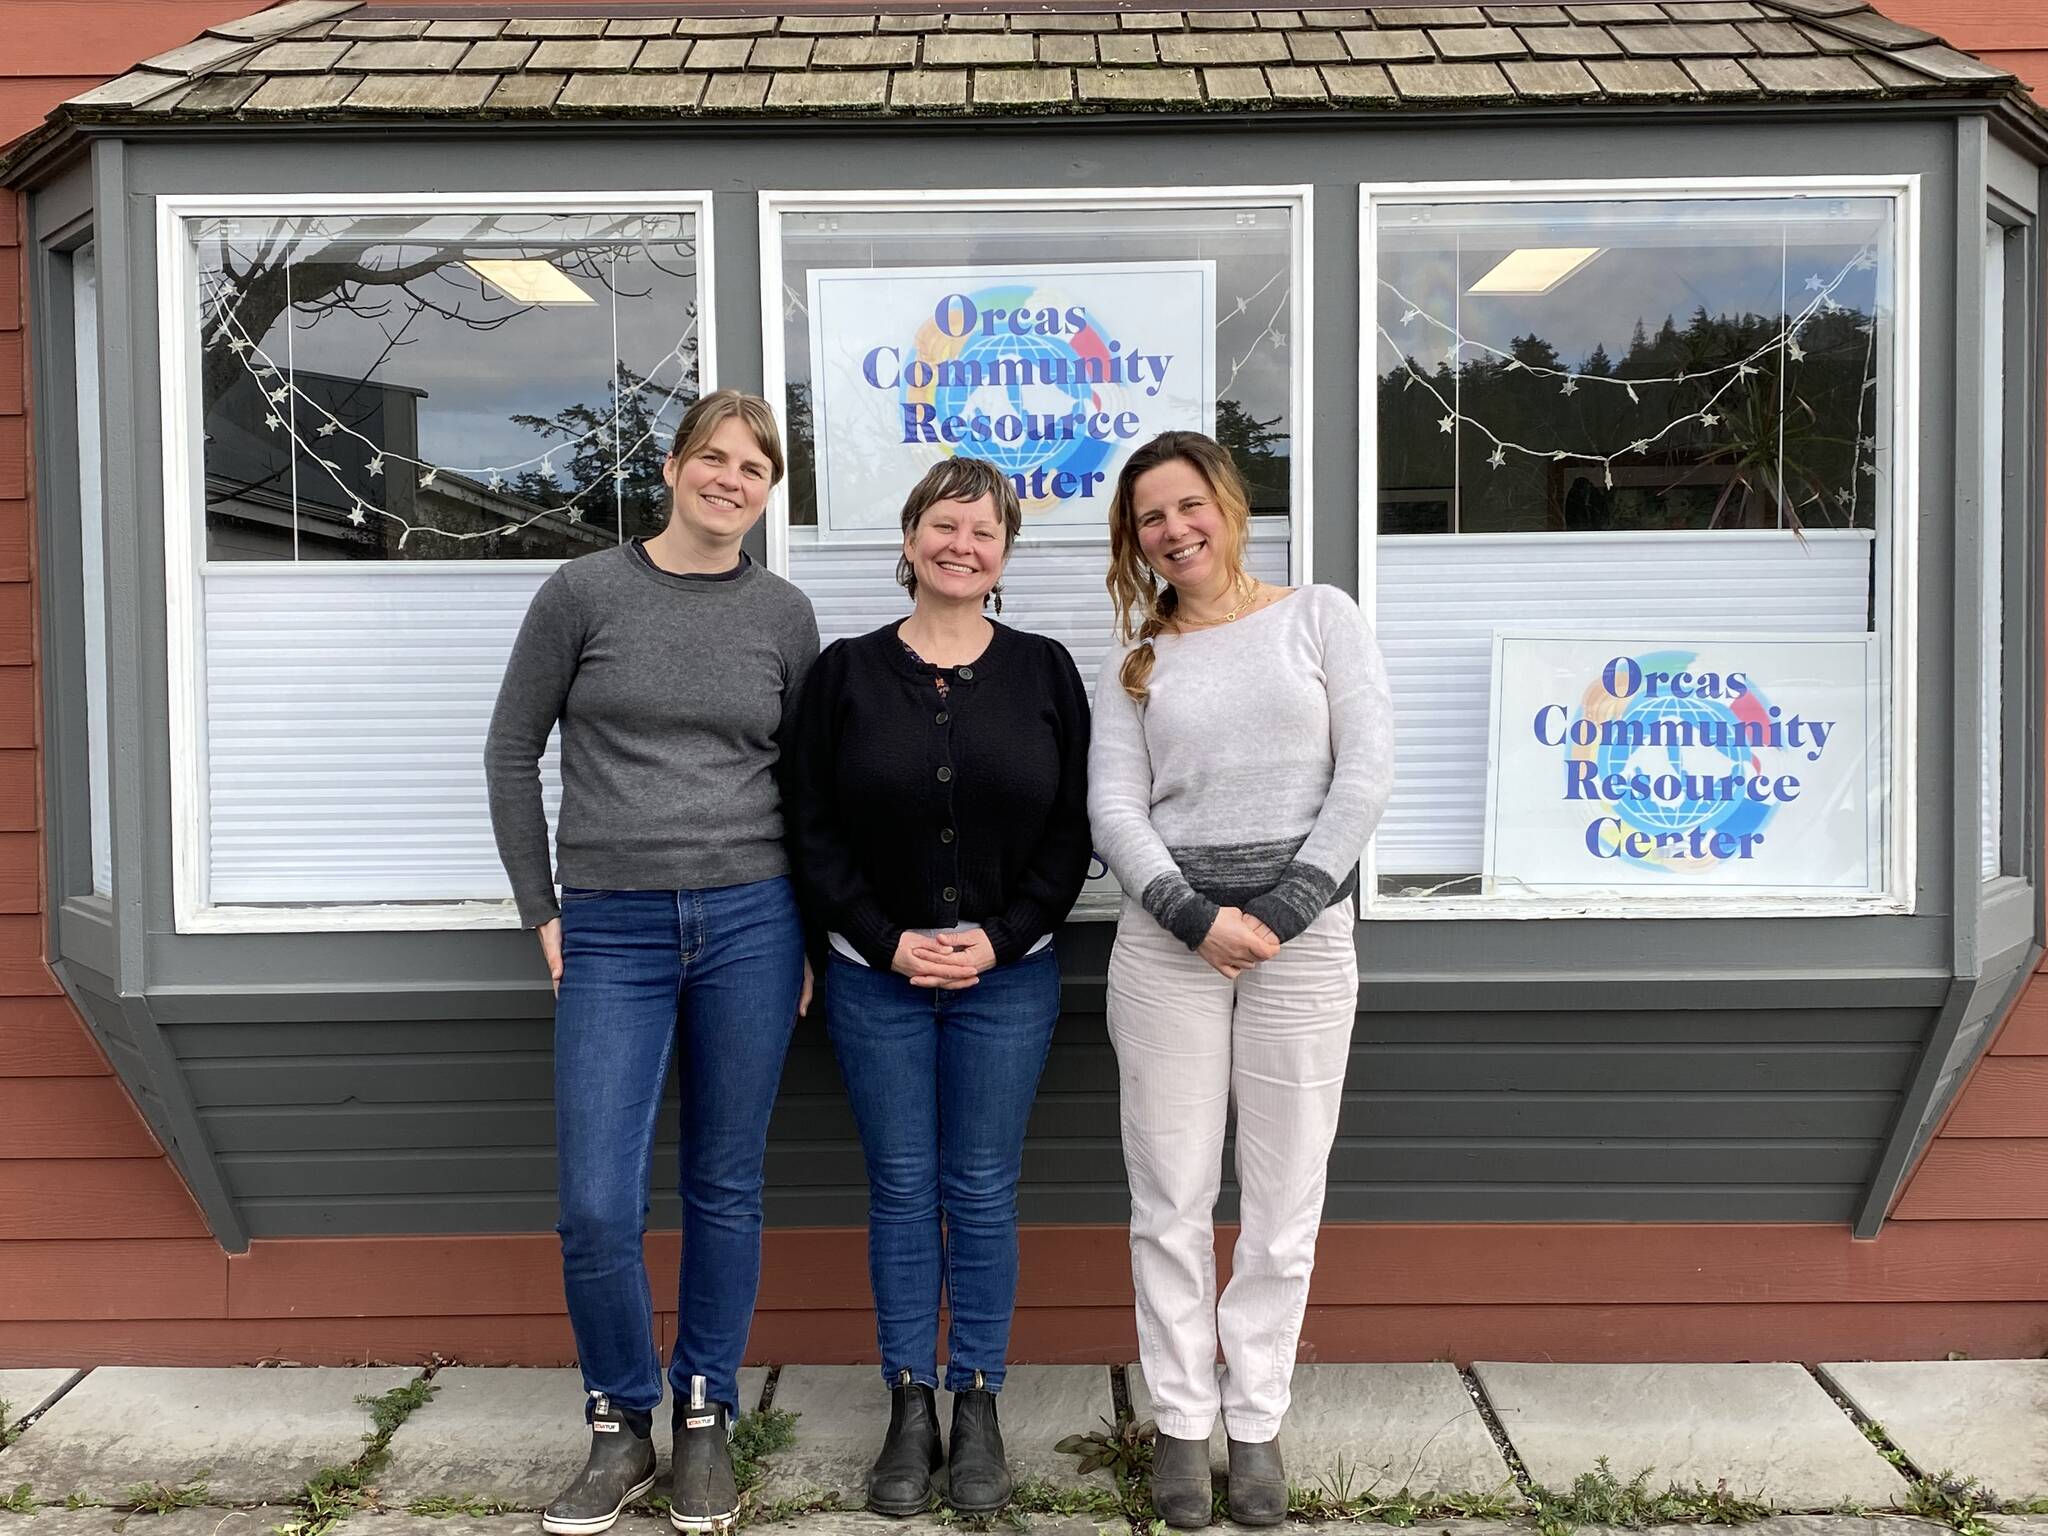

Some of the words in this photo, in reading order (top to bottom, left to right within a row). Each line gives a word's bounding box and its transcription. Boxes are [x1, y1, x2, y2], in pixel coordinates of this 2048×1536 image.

[935, 293, 1087, 338] Orcas
[862, 340, 1175, 396] Community
[901, 402, 1140, 444] Resource
[1008, 464, 1105, 500] nter
[1601, 656, 1747, 699] Orcas
[1533, 704, 1836, 761] Community
[1562, 759, 1801, 802] Resource
[1585, 816, 1764, 859] Center
